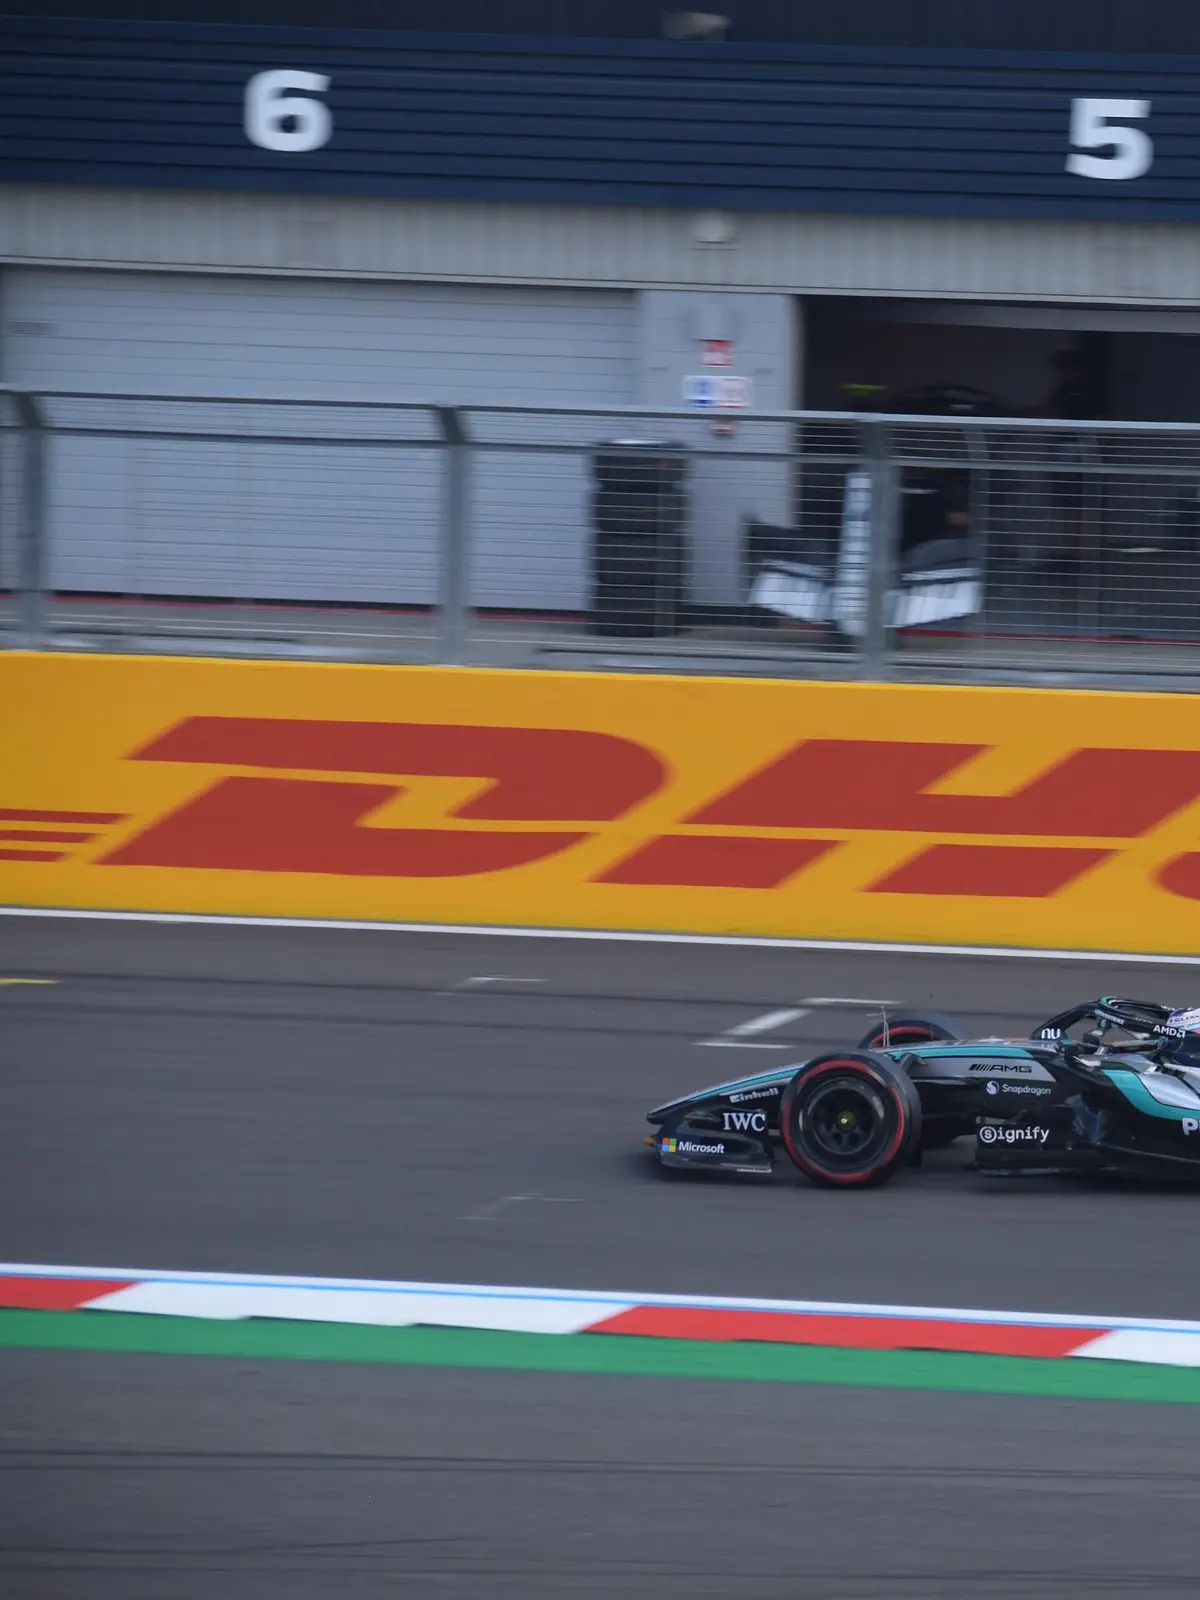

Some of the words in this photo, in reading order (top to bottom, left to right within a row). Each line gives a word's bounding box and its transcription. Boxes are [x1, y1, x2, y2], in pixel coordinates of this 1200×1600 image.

[243, 69, 334, 152] 6
[1064, 98, 1154, 180] 5
[1153, 1025, 1177, 1036] AMD
[989, 1064, 1032, 1073] AMG
[1002, 1083, 1051, 1096] Snapdragon
[722, 1112, 766, 1132] IWC
[678, 1141, 725, 1154] Microsoft
